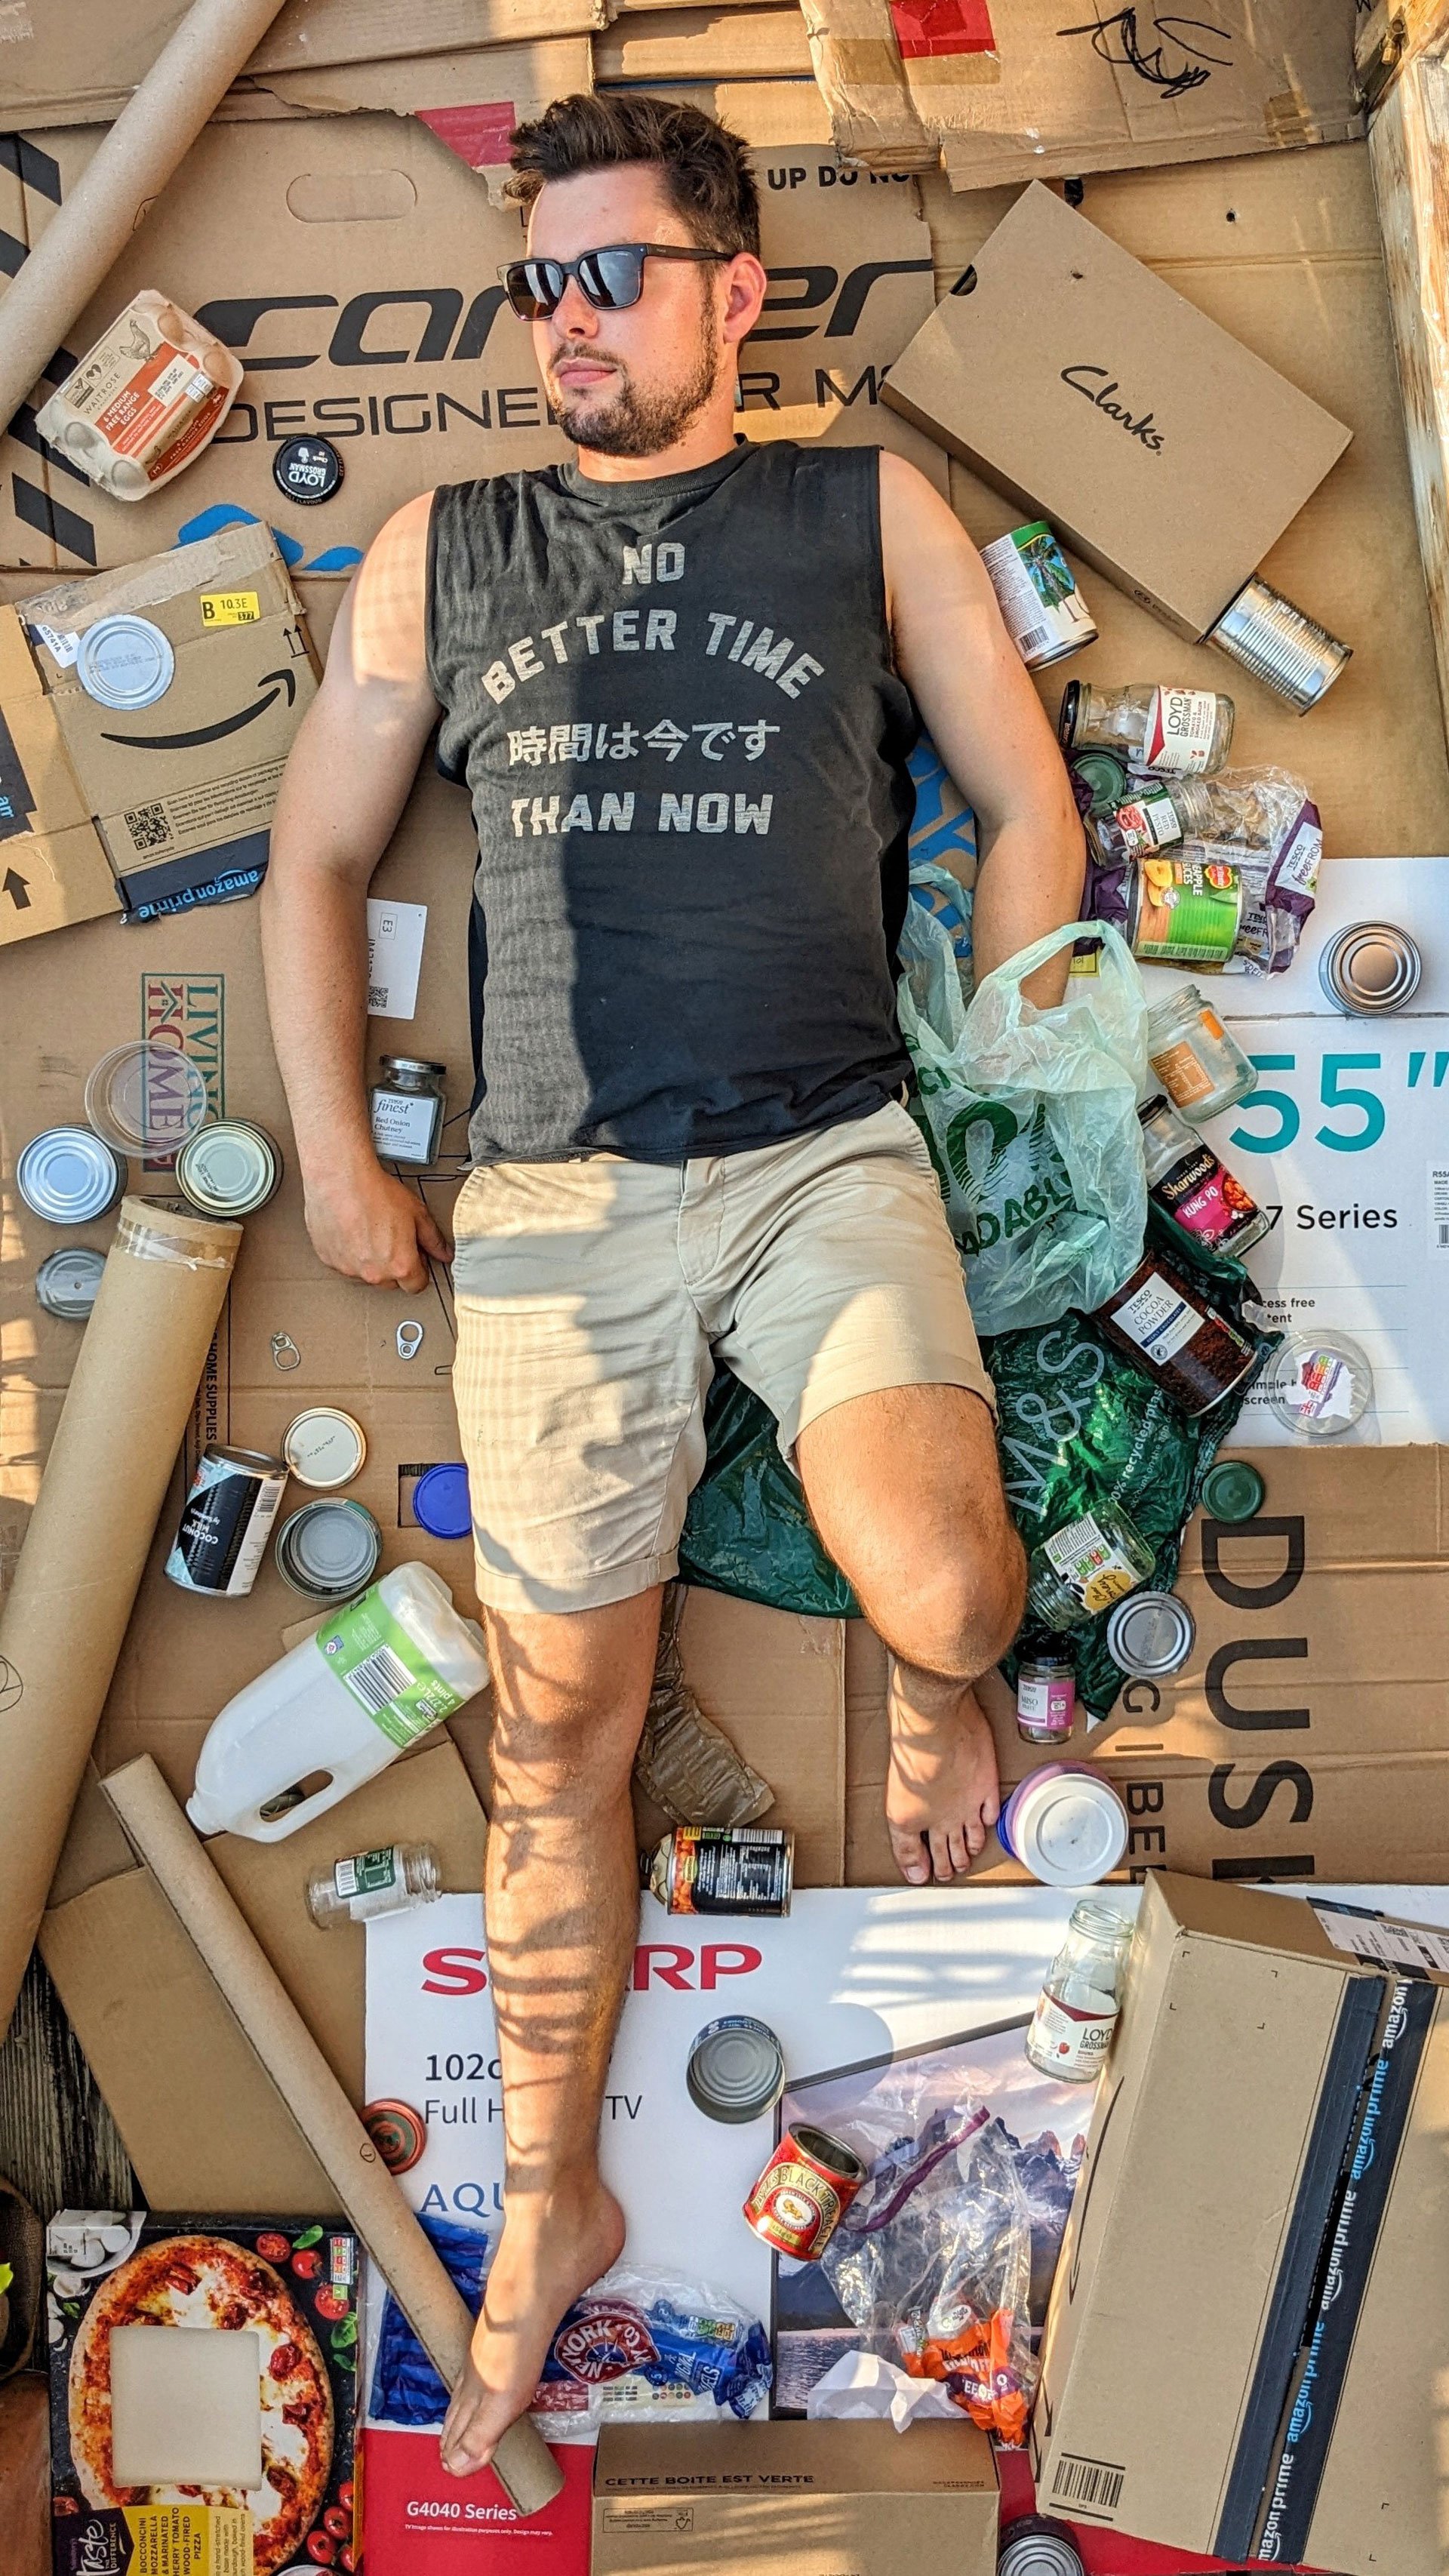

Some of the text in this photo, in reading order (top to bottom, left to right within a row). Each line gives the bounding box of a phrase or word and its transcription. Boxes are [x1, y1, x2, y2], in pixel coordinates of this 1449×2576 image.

[767, 167, 807, 190] UP
[83, 371, 121, 416] WAITROSE
[106, 389, 131, 418] MEDIUM
[1060, 365, 1164, 451] Clarks
[105, 413, 122, 432] FREE
[118, 390, 140, 417] RANGE
[119, 405, 137, 426] EGGS
[212, 386, 554, 444] DESIGNE
[288, 471, 326, 488] LOYD
[289, 462, 326, 475] GROSSMAN
[622, 543, 685, 585] NO
[202, 601, 214, 619] B
[481, 609, 825, 704] BETTER TIME
[1166, 696, 1183, 735] LOYD
[1180, 697, 1192, 737] GROSSMAN
[507, 719, 780, 767] 時間は今です
[511, 792, 774, 838] THAN NOW
[1152, 813, 1164, 836] PESTO
[1160, 814, 1169, 830] RED
[1287, 842, 1304, 869] TESCO
[1290, 834, 1324, 887] freeFROM
[194, 869, 260, 902] amazon
[381, 919, 393, 933] E3
[148, 982, 183, 1130] HOME
[374, 1097, 410, 1117] finest
[375, 1116, 411, 1128] Red Onion
[374, 1123, 402, 1134] Chutney
[1156, 1151, 1221, 1202] Sharwood's
[1180, 1184, 1220, 1219] KUNG PO
[1296, 1204, 1398, 1230] Series
[1127, 1288, 1151, 1313] TESCO
[1133, 1293, 1164, 1327] COCOA
[1137, 1297, 1174, 1336] POWDER
[1291, 1297, 1315, 1307] free
[1146, 1328, 1161, 1344] DEEPLY
[206, 1343, 217, 1381] HOME
[205, 1383, 217, 1439] SUPPLIES
[1244, 1396, 1284, 1405] screen
[1001, 1330, 1105, 1516] M&S
[1155, 1424, 1176, 1446] app
[1112, 1417, 1163, 1481] recycled
[1147, 1442, 1165, 1461] the
[180, 1522, 220, 1545] COCONUT
[190, 1519, 211, 1532] MILK
[426, 1678, 456, 1707] 4 pints
[1020, 1695, 1038, 1705] MISO
[420, 1943, 762, 1996] SRP
[1081, 2024, 1112, 2043] LOYD
[1381, 1984, 1408, 2049] amazon
[424, 2094, 643, 2124] Full TV
[1349, 2058, 1392, 2180] amazon prime
[776, 2165, 826, 2199] BLACK
[1334, 2189, 1360, 2246] prime
[1285, 2377, 1312, 2442] amazon
[605, 2474, 814, 2485] CETTE BOITE EST VERTE
[406, 2501, 518, 2522] G4040 Series
[1257, 2452, 1298, 2562] mazon prime
[109, 2522, 118, 2569] DIFFERENCE
[139, 2517, 147, 2573] BOCCONCINI
[149, 2515, 158, 2574] MOZZARELLA
